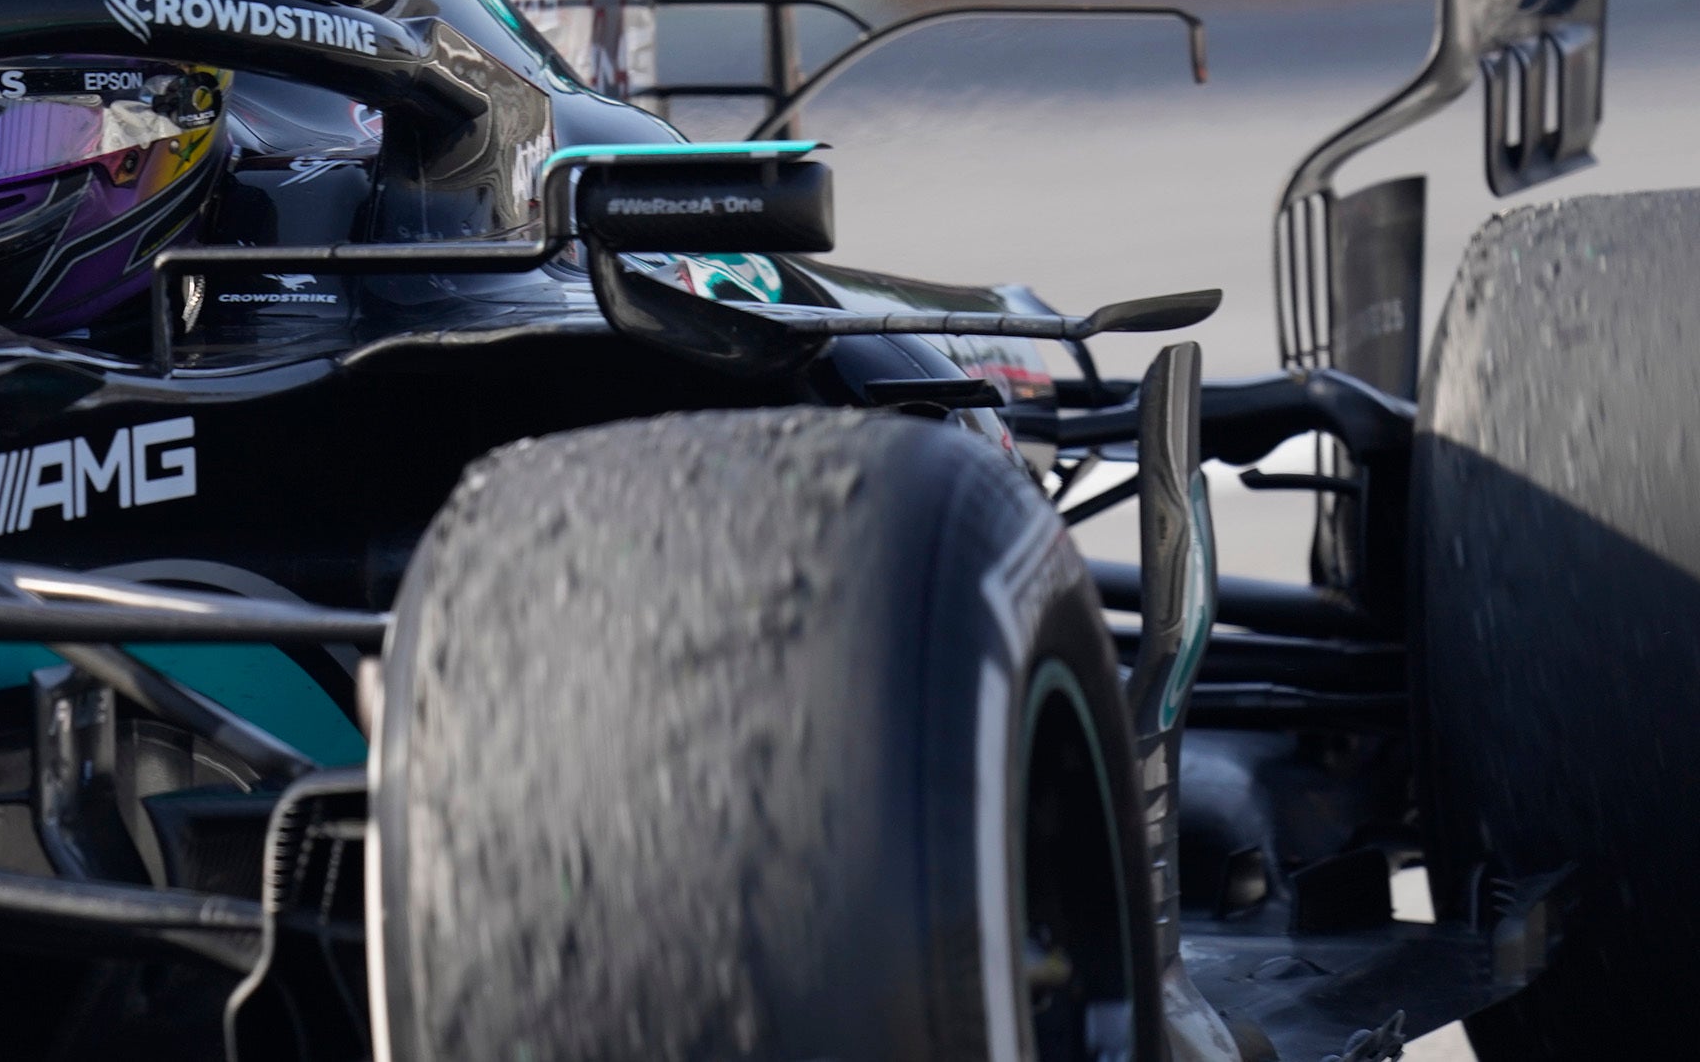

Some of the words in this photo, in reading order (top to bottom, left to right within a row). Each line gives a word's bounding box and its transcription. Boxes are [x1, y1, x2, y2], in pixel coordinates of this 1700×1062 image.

[84, 71, 144, 91] EPSON
[606, 195, 765, 215] #WeRaceAOne
[218, 293, 338, 304] CROWDSTRIKE
[19, 416, 197, 530] AMG
